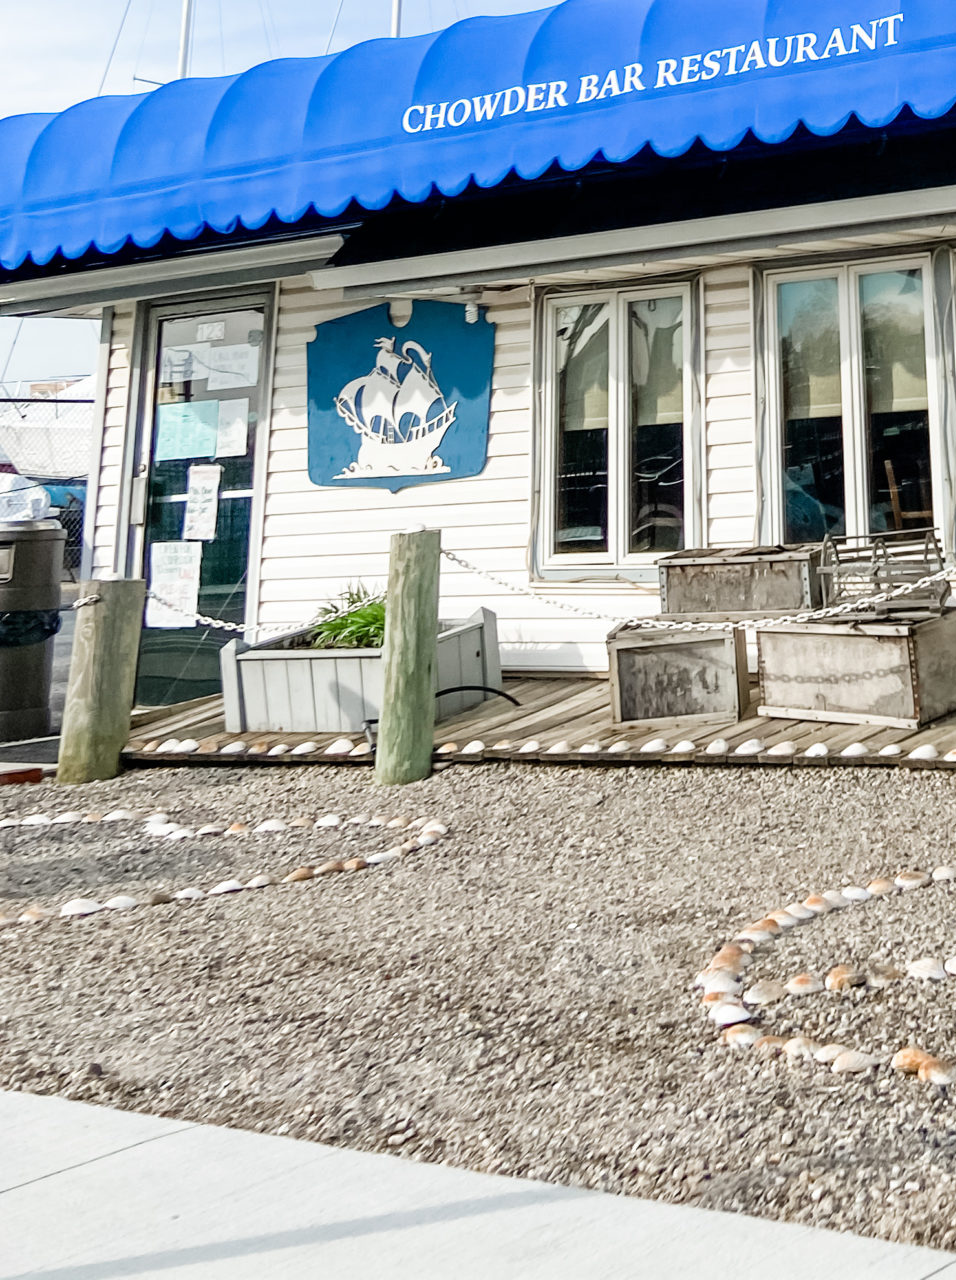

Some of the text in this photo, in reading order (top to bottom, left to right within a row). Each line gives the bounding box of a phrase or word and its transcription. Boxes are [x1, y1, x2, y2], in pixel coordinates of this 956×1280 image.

[402, 13, 904, 133] CHOWDER BAR RESTAURANT
